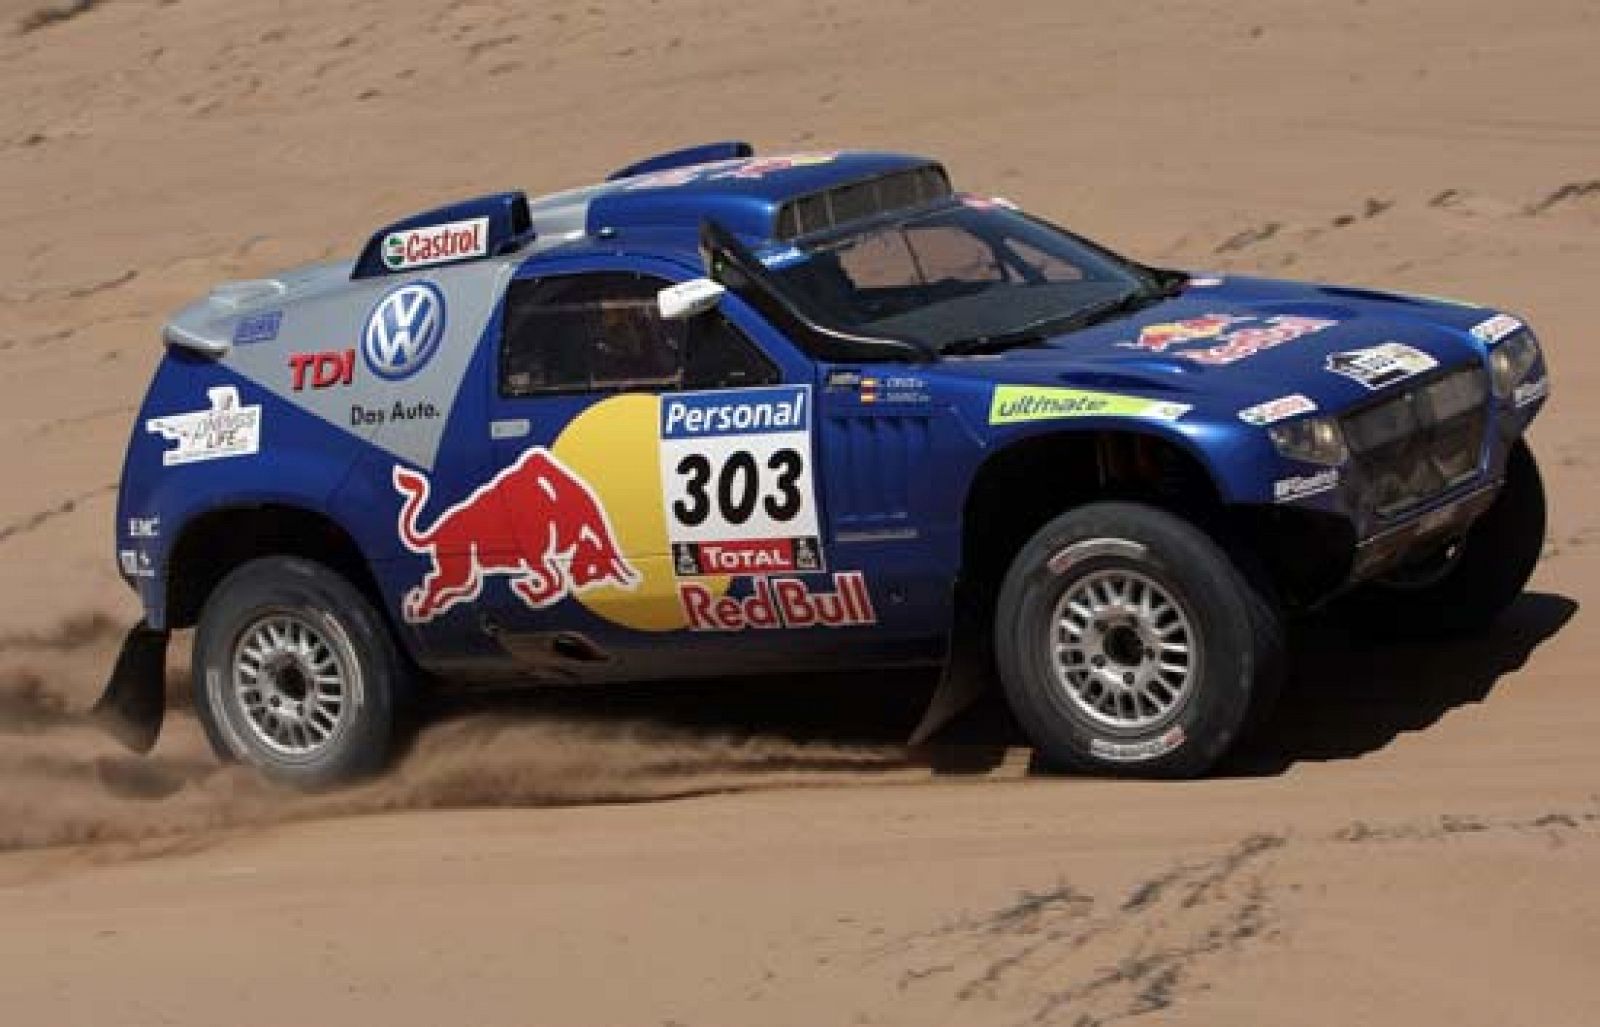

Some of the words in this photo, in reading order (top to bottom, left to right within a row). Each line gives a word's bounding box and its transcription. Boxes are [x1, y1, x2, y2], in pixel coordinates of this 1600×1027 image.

[407, 224, 480, 262] Castrol
[288, 349, 355, 392] TDI
[351, 404, 385, 425] Das
[391, 401, 440, 421] Auto.
[666, 393, 803, 434] Personal
[672, 448, 803, 527] 303
[703, 546, 791, 568] TOTAL
[679, 575, 779, 630] Red
[774, 572, 875, 626] Bull
